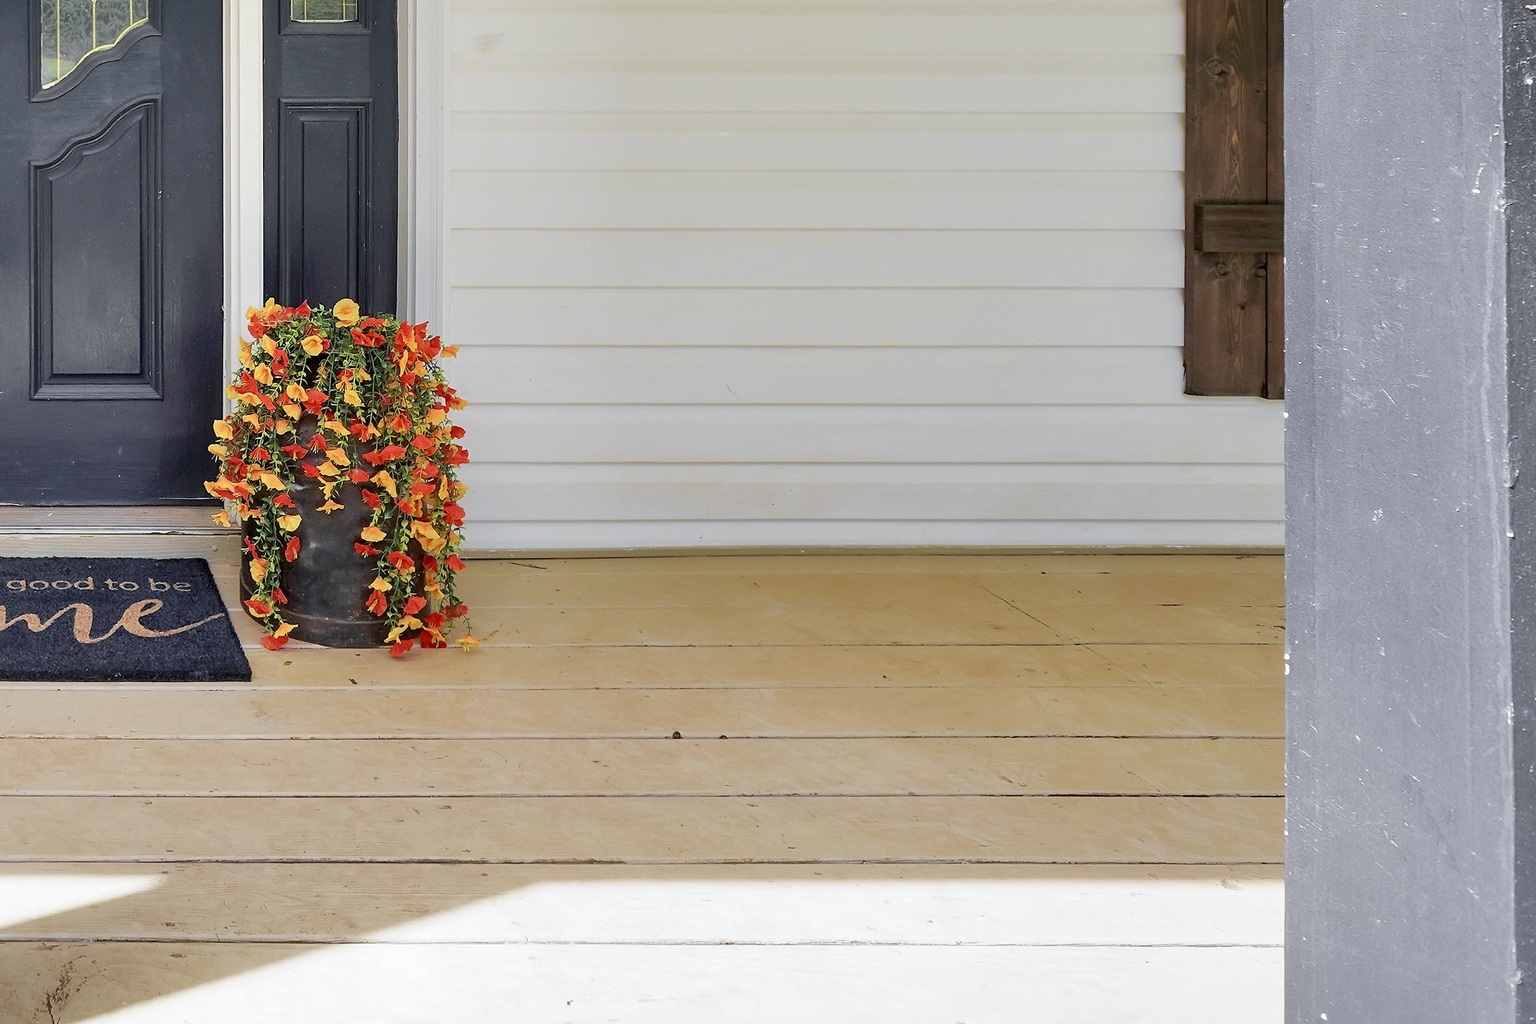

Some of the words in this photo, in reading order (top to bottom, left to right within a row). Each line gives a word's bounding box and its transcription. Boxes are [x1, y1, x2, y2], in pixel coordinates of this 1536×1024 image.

[6, 575, 95, 594] good
[104, 576, 139, 592] to
[148, 577, 192, 593] be
